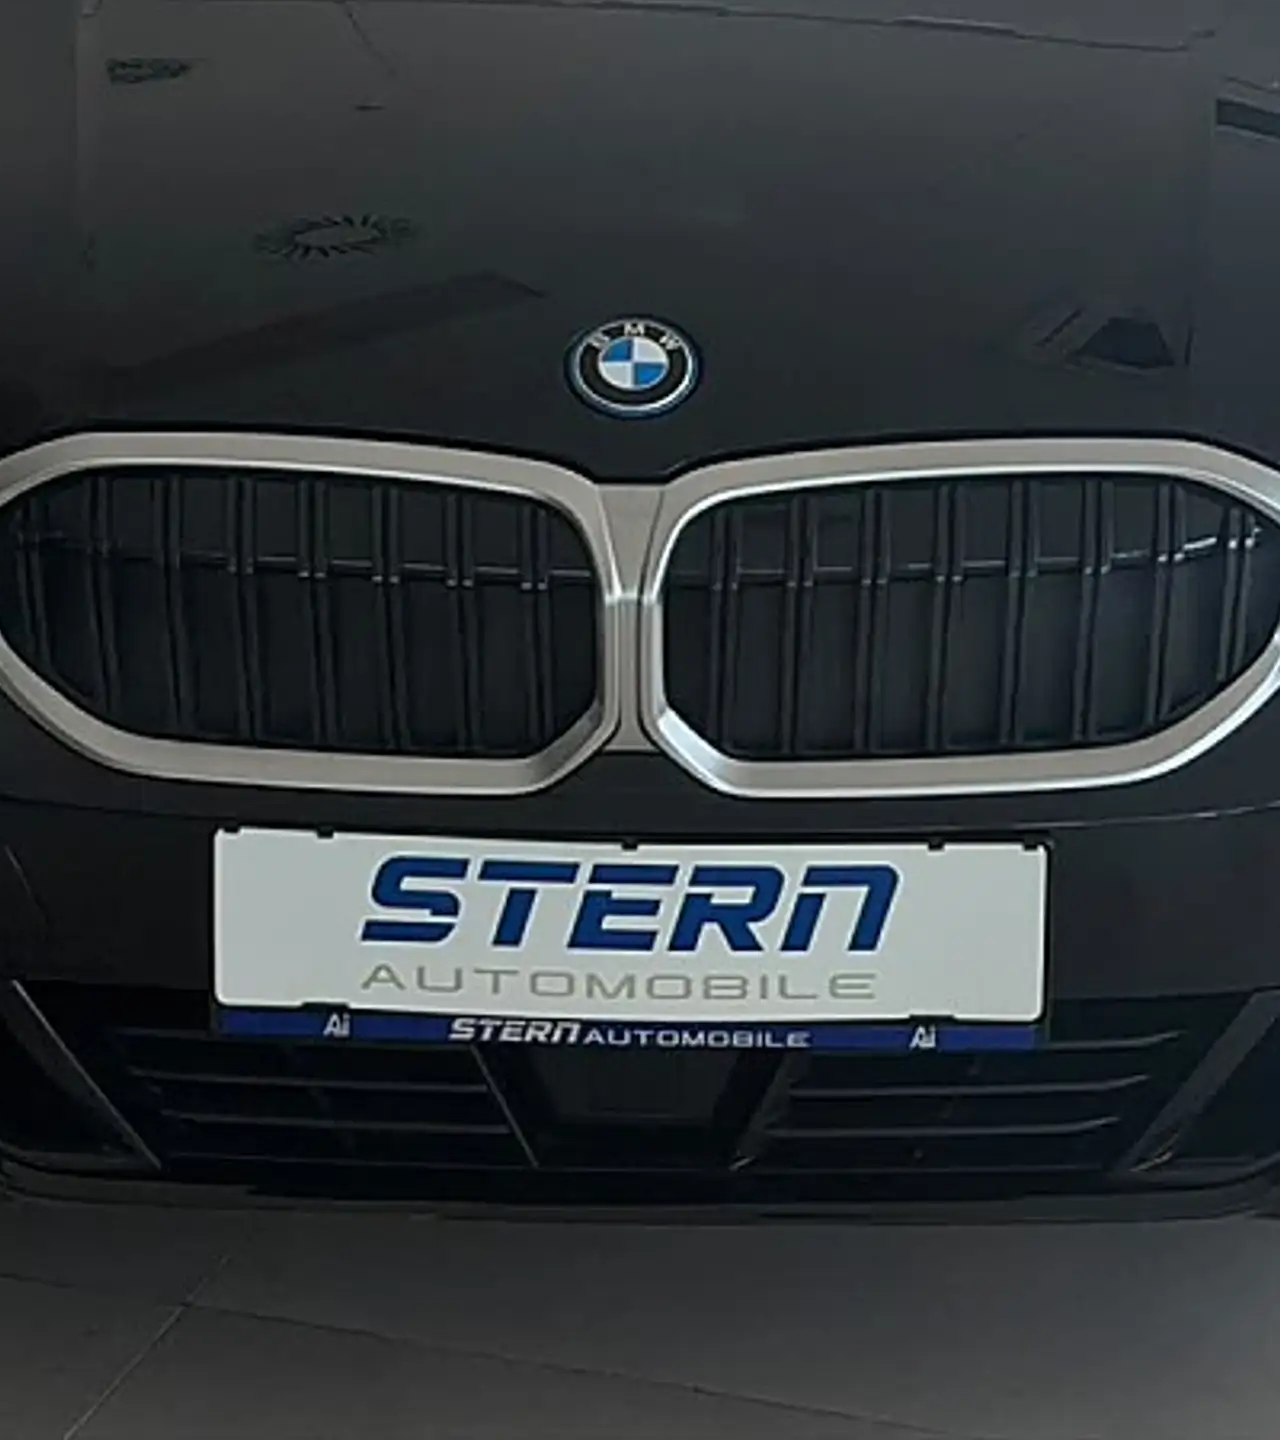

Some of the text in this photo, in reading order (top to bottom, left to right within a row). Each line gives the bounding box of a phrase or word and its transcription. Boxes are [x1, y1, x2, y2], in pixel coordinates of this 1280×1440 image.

[360, 855, 899, 953] STERN
[360, 963, 878, 1001] AUTOMOBILE
[583, 1025, 812, 1049] AUTOMOBILE
